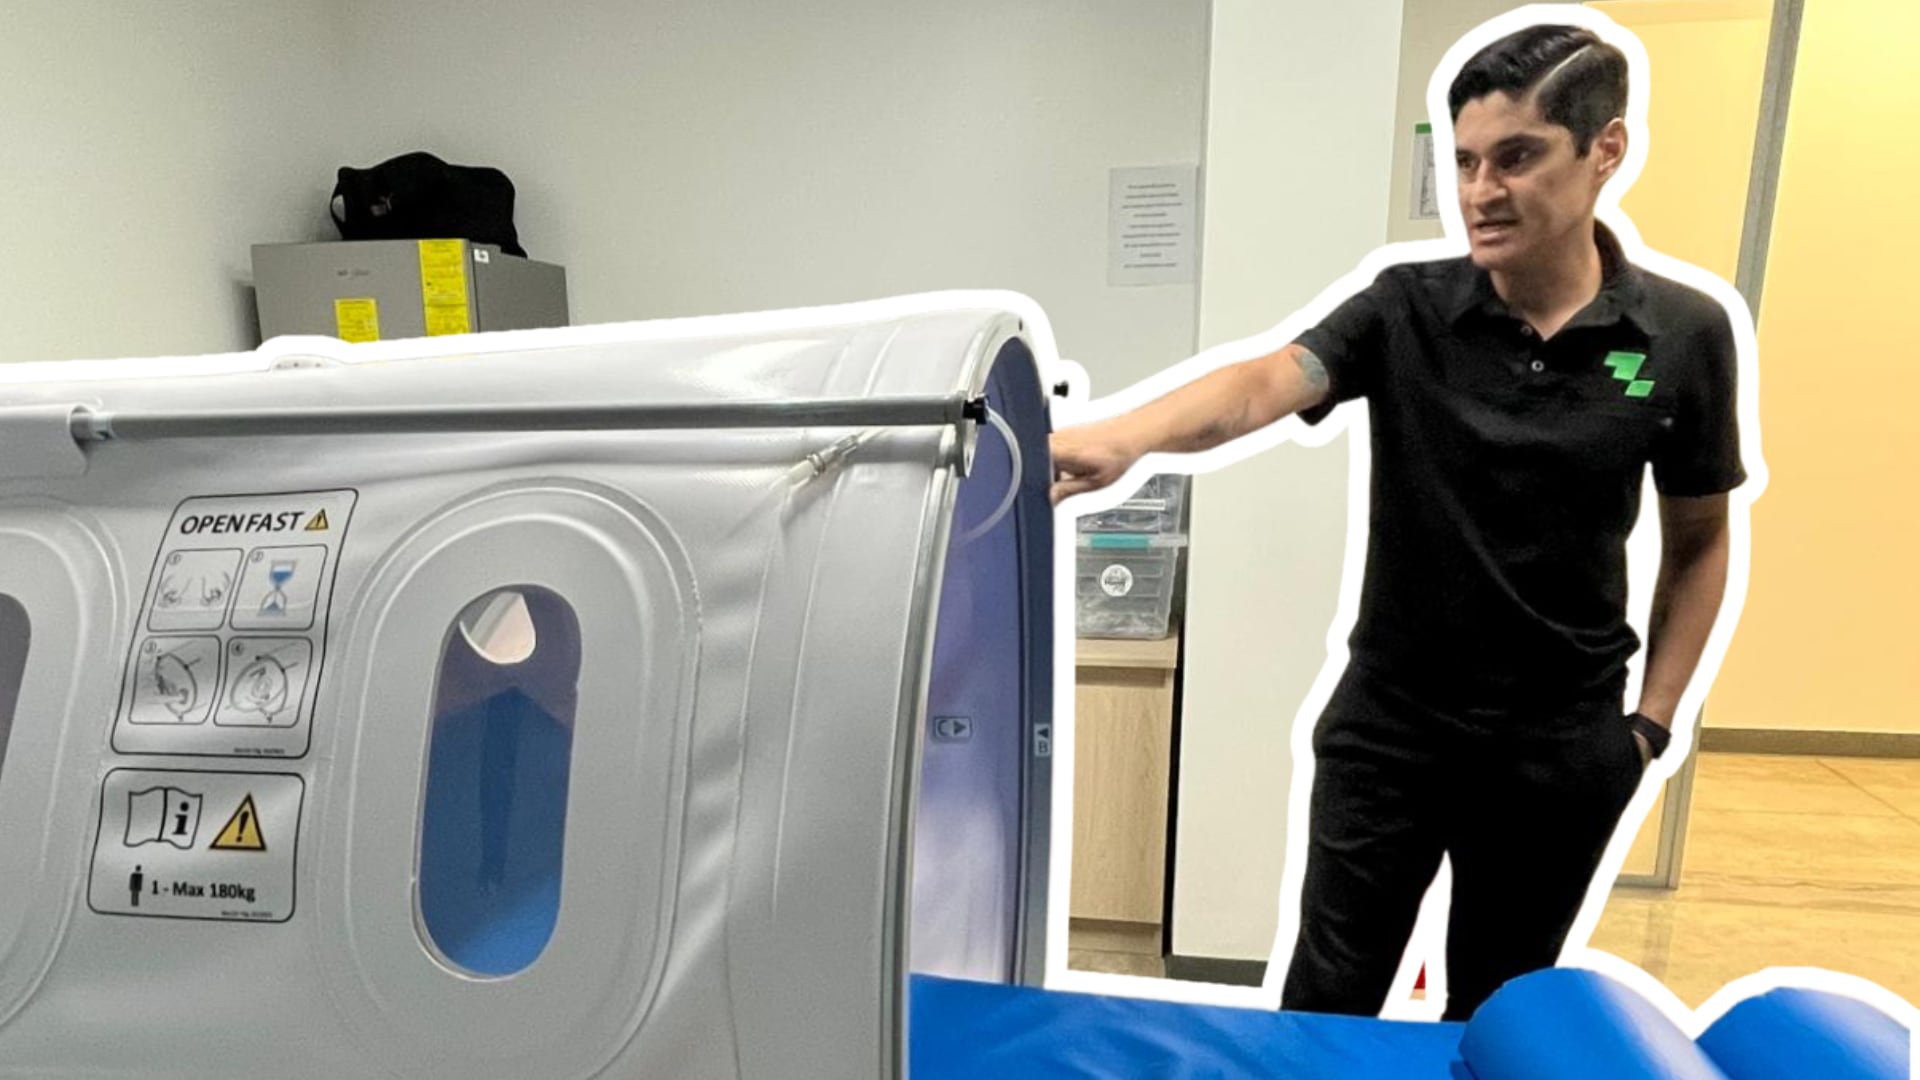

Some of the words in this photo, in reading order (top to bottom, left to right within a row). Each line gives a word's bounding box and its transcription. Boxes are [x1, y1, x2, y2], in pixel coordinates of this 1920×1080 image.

[180, 513, 245, 535] OPEN
[245, 511, 305, 533] FAST
[151, 880, 158, 895] 1
[172, 881, 205, 897] Max
[210, 883, 256, 902] 180kg
